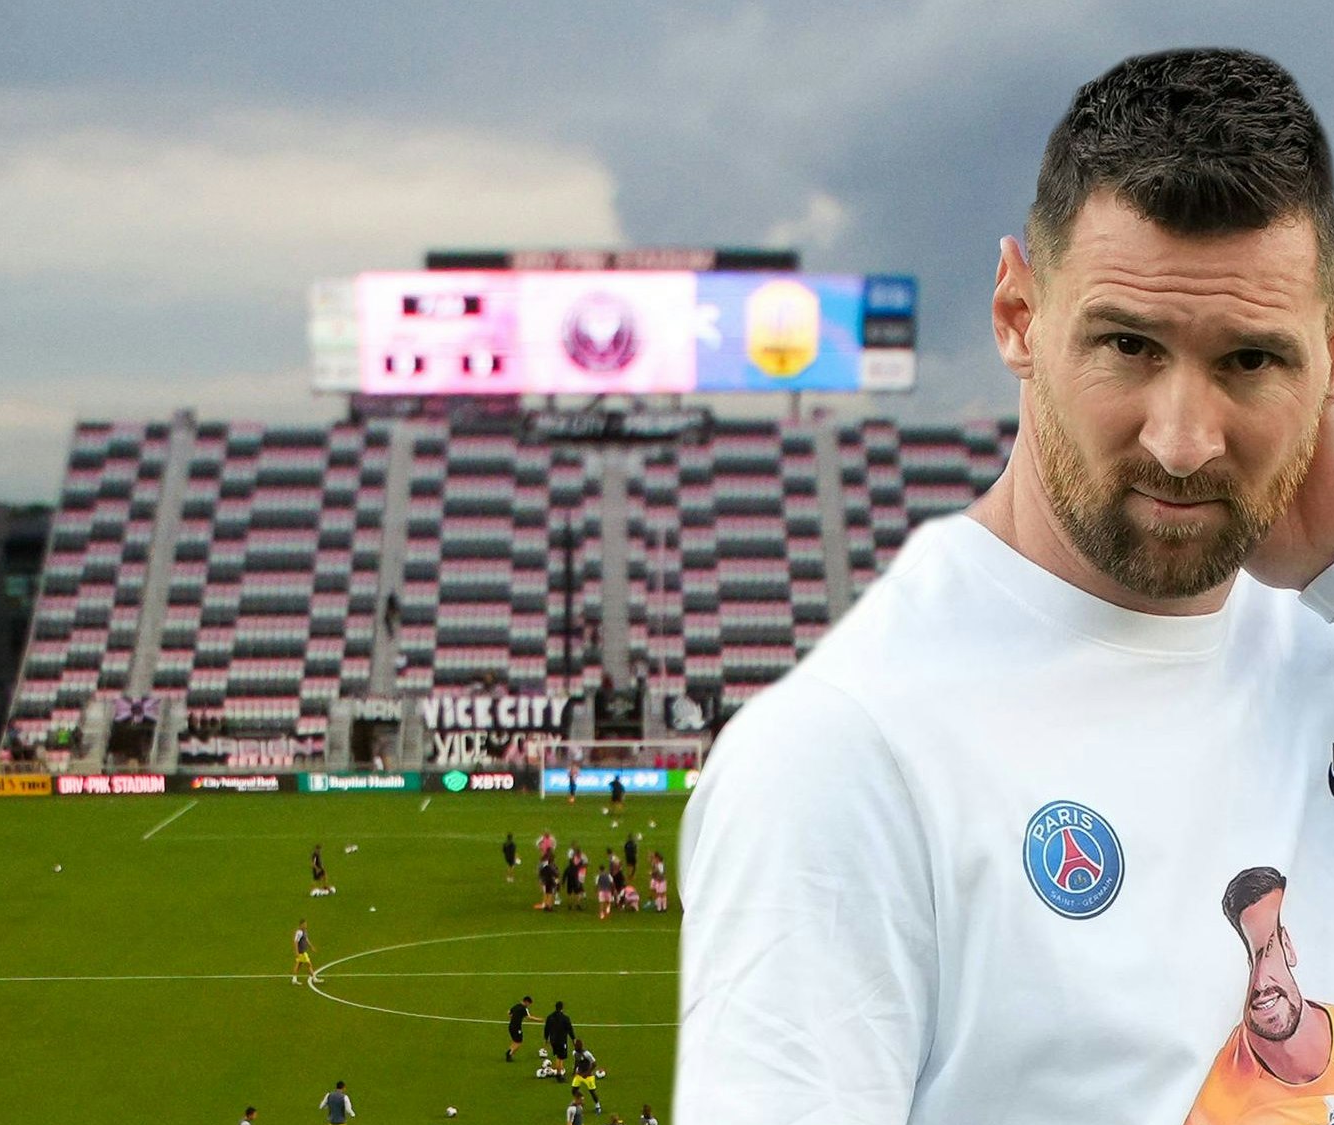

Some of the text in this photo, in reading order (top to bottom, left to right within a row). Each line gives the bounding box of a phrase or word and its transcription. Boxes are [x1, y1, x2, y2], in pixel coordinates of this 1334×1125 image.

[423, 695, 494, 729] VICE
[498, 695, 570, 728] CITY
[112, 775, 166, 793] STADIUM
[328, 775, 405, 790] Baptist Health
[1032, 808, 1094, 842] PARIS
